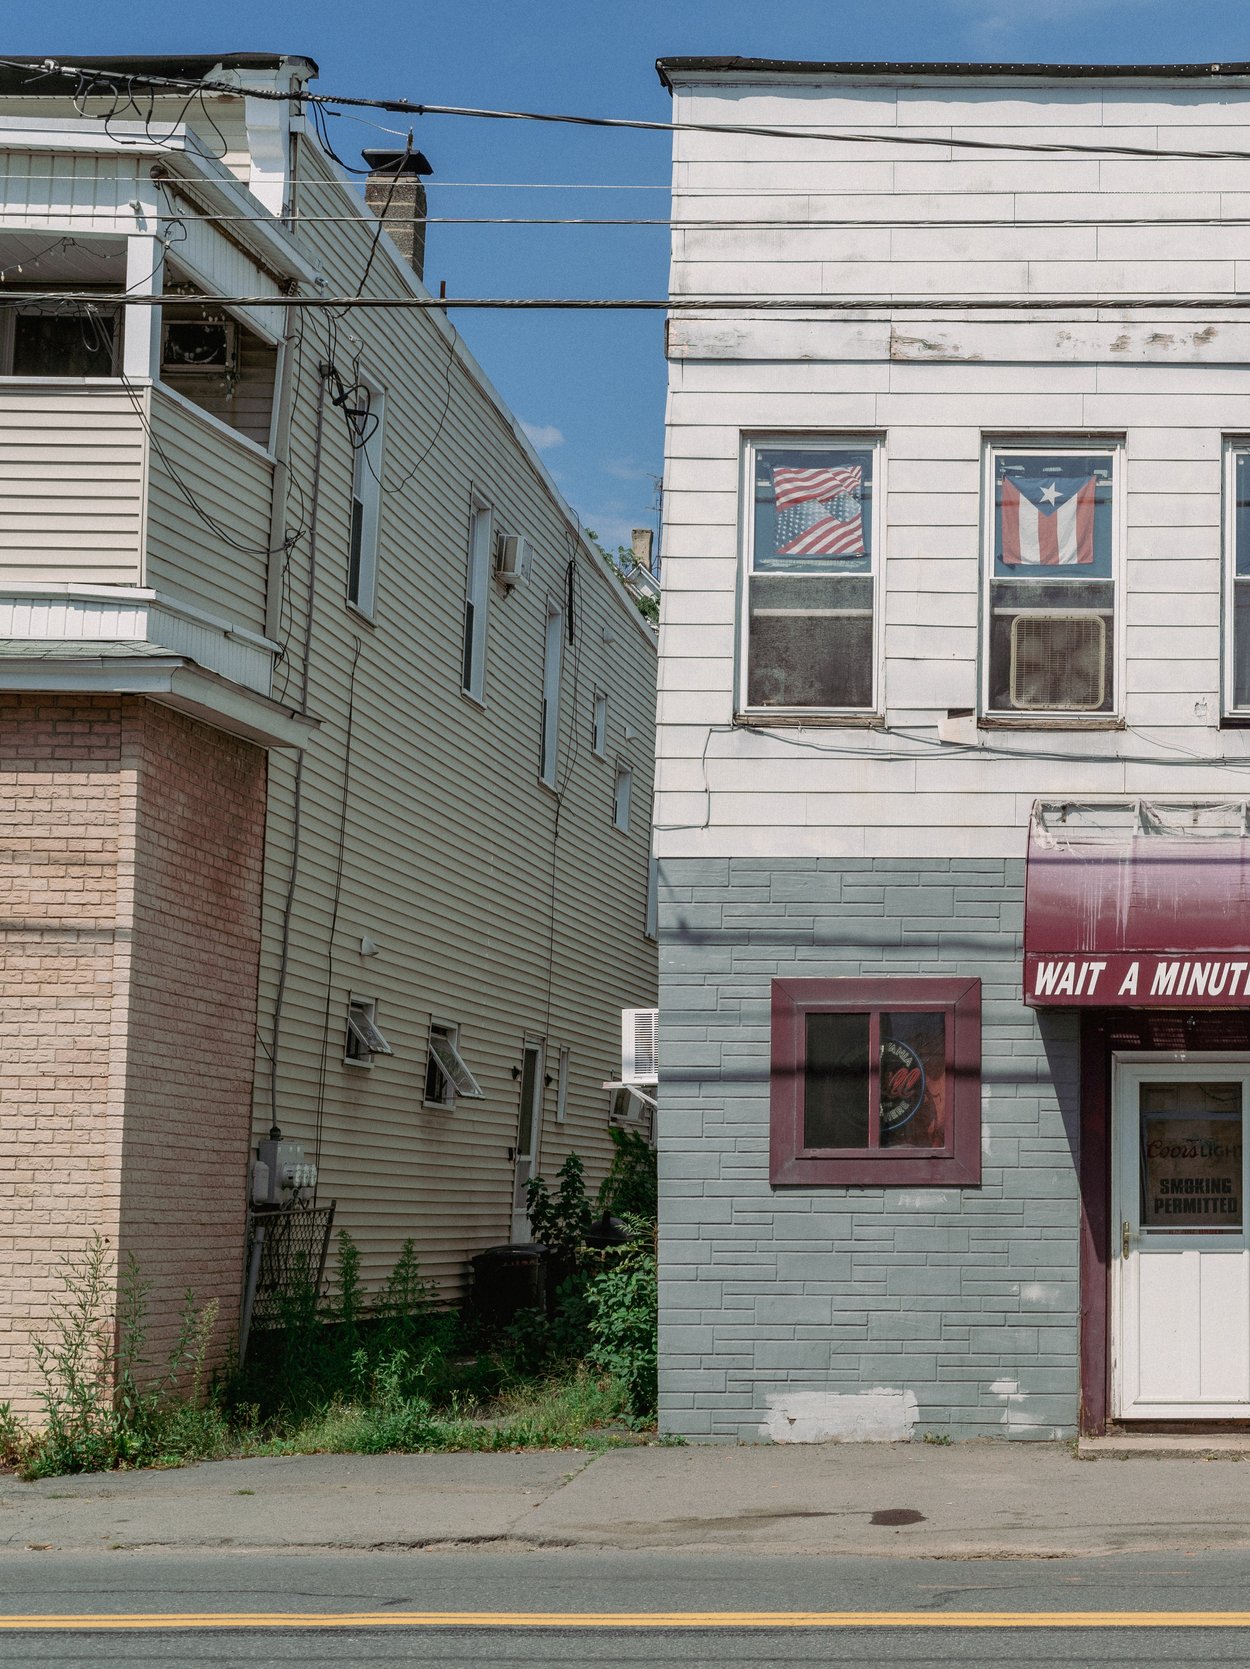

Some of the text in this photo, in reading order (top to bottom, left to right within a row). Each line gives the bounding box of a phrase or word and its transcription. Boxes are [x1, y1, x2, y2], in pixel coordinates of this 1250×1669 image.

[1034, 962, 1106, 996] WAIT
[1118, 962, 1140, 996] A
[1148, 1139, 1198, 1159] Coors
[1160, 1178, 1231, 1194] SMOKING
[1154, 1197, 1238, 1214] PERMITTED
